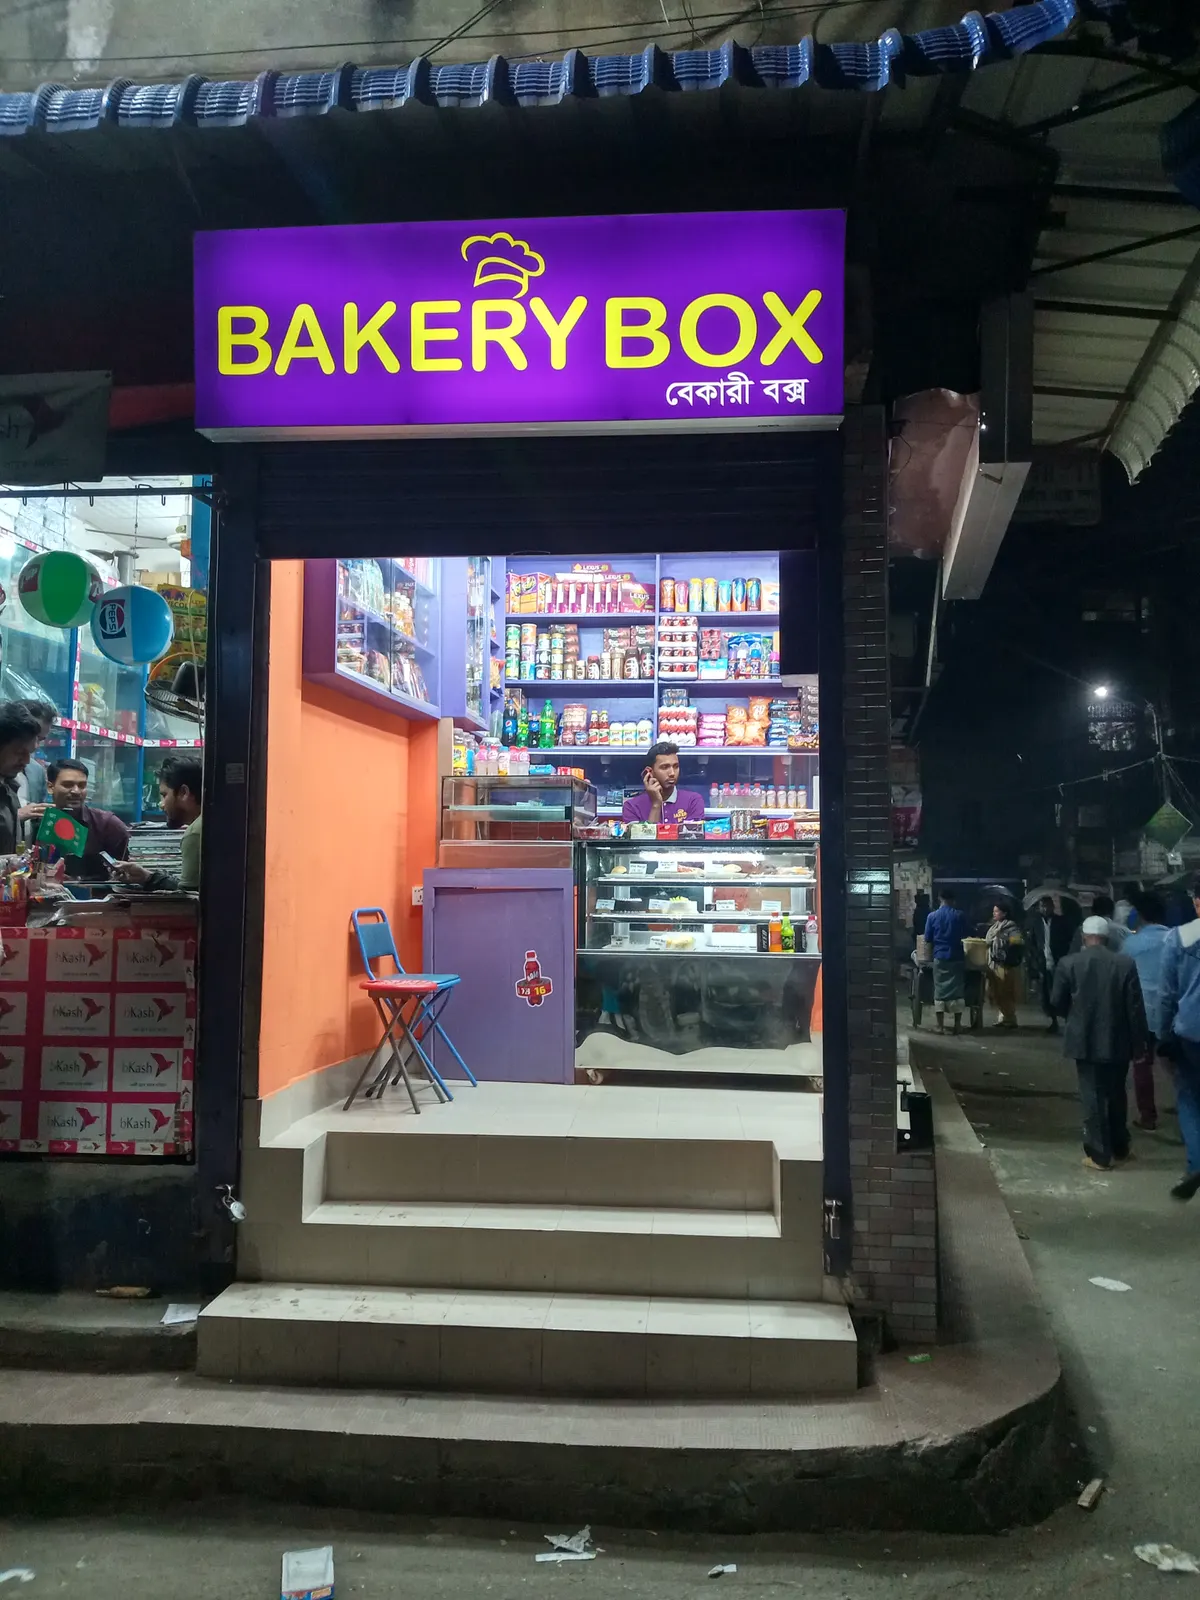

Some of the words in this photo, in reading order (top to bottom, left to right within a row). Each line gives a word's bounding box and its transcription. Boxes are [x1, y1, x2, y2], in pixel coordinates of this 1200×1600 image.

[218, 296, 587, 375] BAKERY
[606, 289, 823, 369] BOX
[665, 371, 755, 406] বেকারী
[759, 378, 810, 405] বক্স
[629, 592, 650, 600] LEXUS
[109, 603, 118, 633] PEPSI
[54, 949, 86, 964] bKash
[126, 950, 157, 964] bKash
[53, 1004, 83, 1018] bKash
[124, 1004, 155, 1018] bKash
[49, 1059, 81, 1073] bKash
[121, 1060, 153, 1074] bKash
[47, 1114, 78, 1129] bKash
[119, 1115, 151, 1130] bKash
